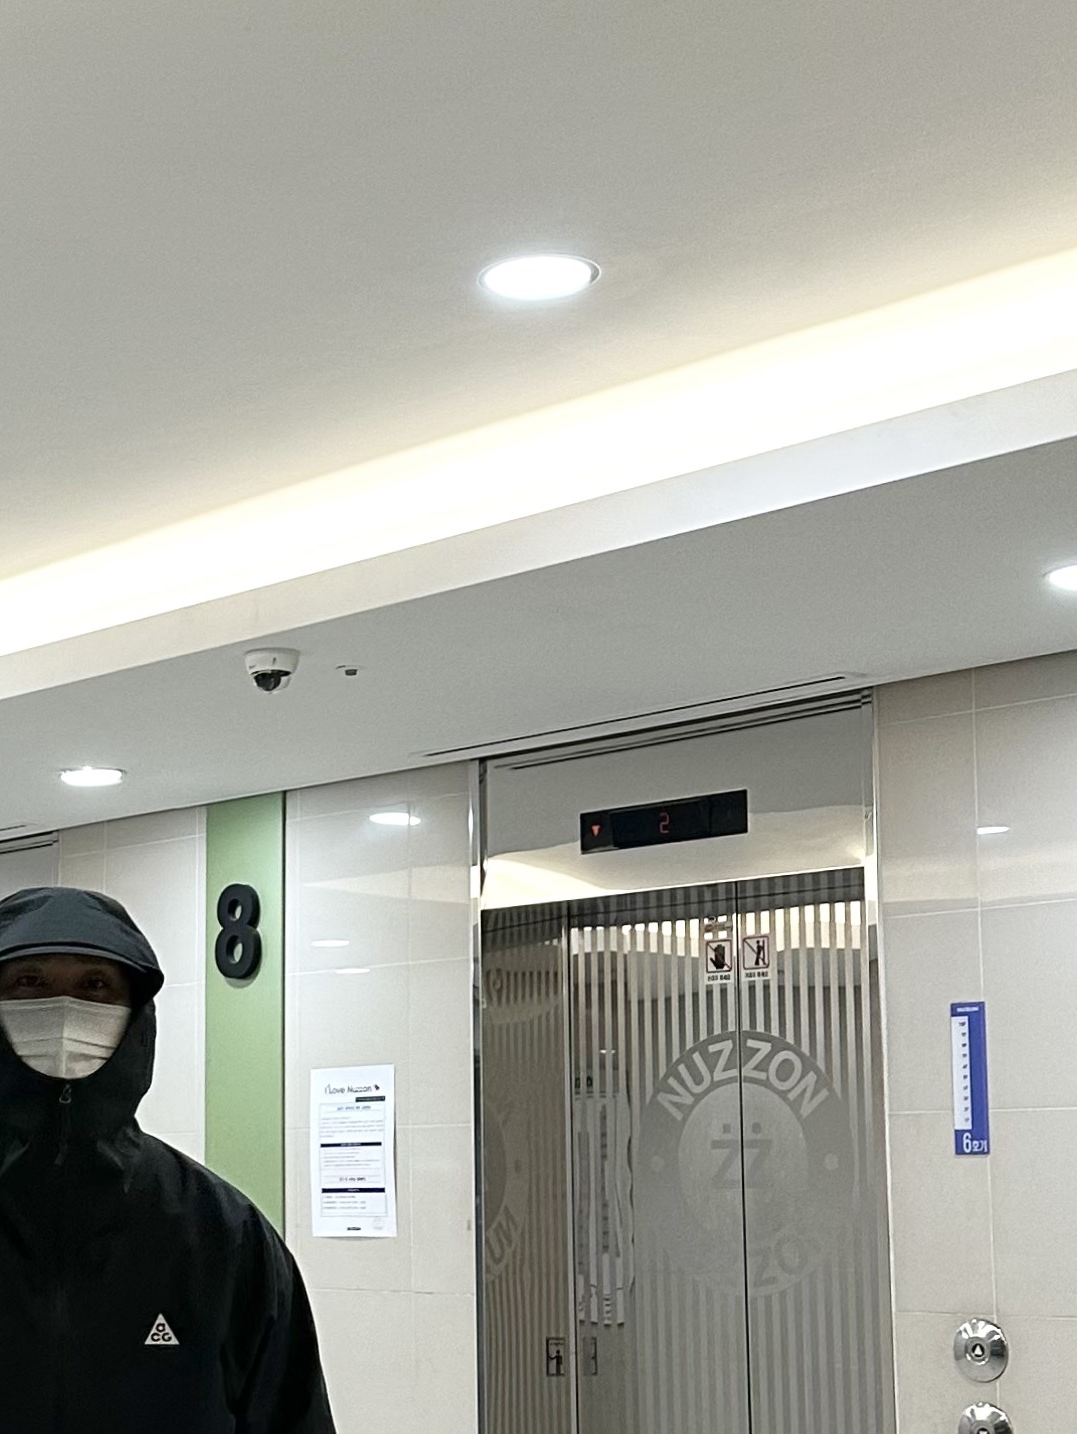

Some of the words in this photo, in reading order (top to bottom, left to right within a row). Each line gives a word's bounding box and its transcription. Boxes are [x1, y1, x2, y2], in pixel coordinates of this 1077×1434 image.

[658, 811, 671, 835] 2
[215, 883, 262, 979] 8
[657, 1039, 829, 1121] NUZZON
